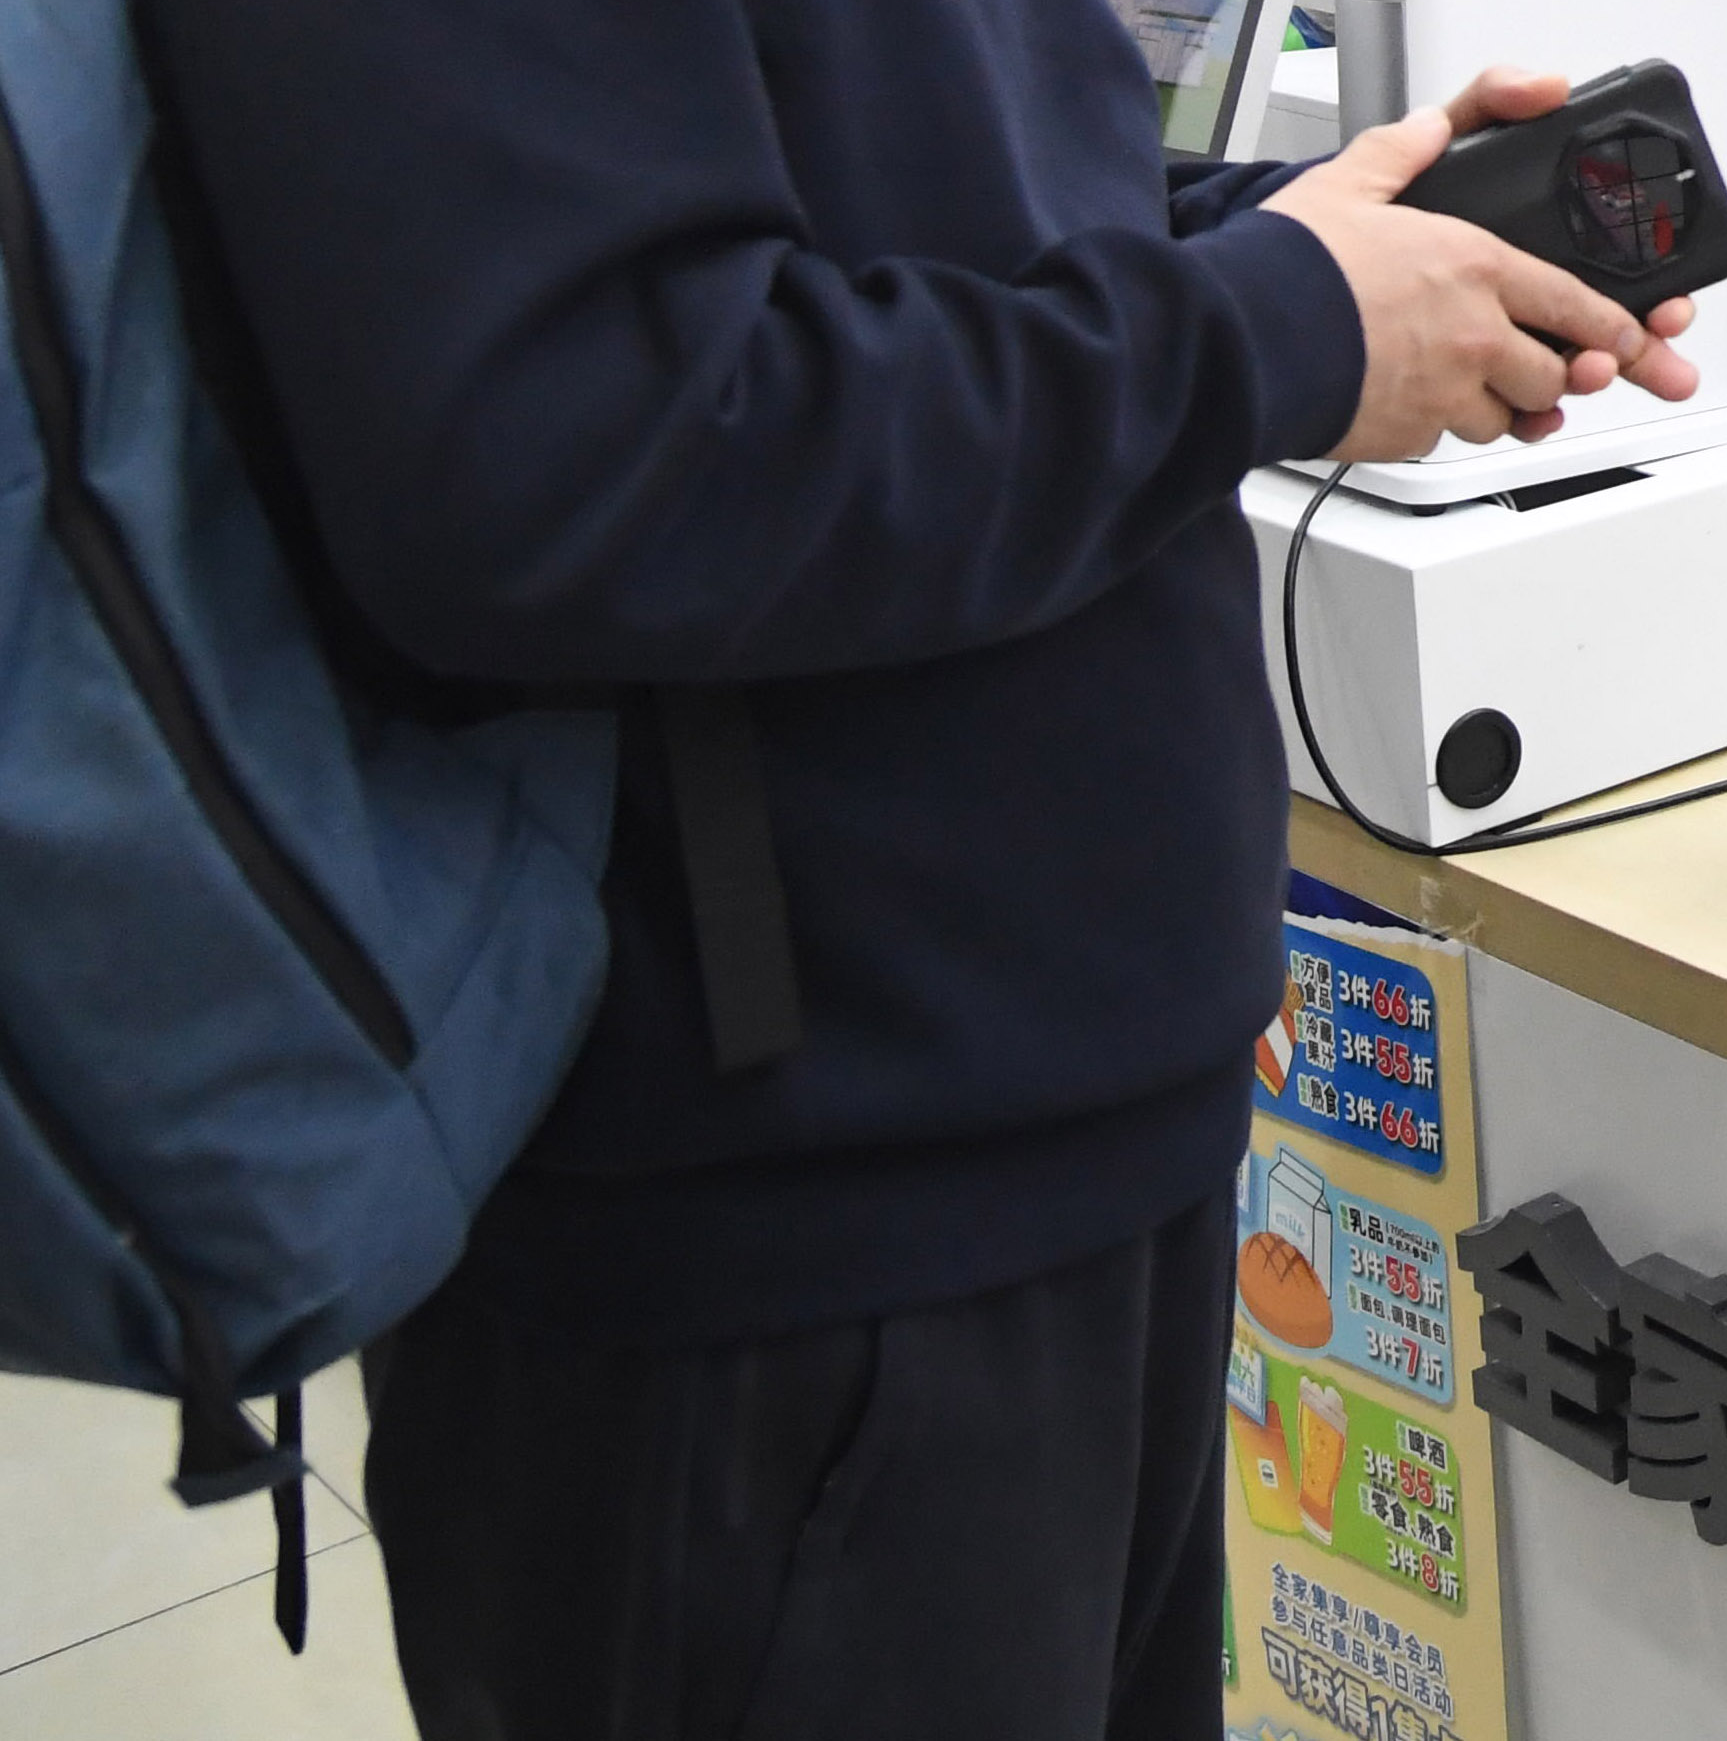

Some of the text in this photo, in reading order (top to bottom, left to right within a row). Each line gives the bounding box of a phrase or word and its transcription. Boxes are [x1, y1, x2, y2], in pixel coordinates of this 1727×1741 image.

[1303, 955, 1332, 986] 方便
[1304, 983, 1333, 1013] 食品
[1338, 970, 1432, 1031] 3件66折
[1307, 1041, 1335, 1071] 果汁
[1340, 1029, 1434, 1089] 3件55折
[1310, 1078, 1338, 1119] 熟食
[1343, 1092, 1439, 1154] 3件66折
[1275, 1211, 1305, 1237] milk
[1349, 1207, 1384, 1244] 乳品
[1350, 1245, 1444, 1309] 3件55折
[1366, 1325, 1443, 1386] 3件7折
[1408, 1428, 1446, 1470] 啤酒
[1363, 1445, 1455, 1515] 3件55折
[1372, 1490, 1454, 1557] 零食、熟食
[1386, 1538, 1459, 1601] 3件8折
[1272, 1595, 1452, 1718] 参与任意品类日活动
